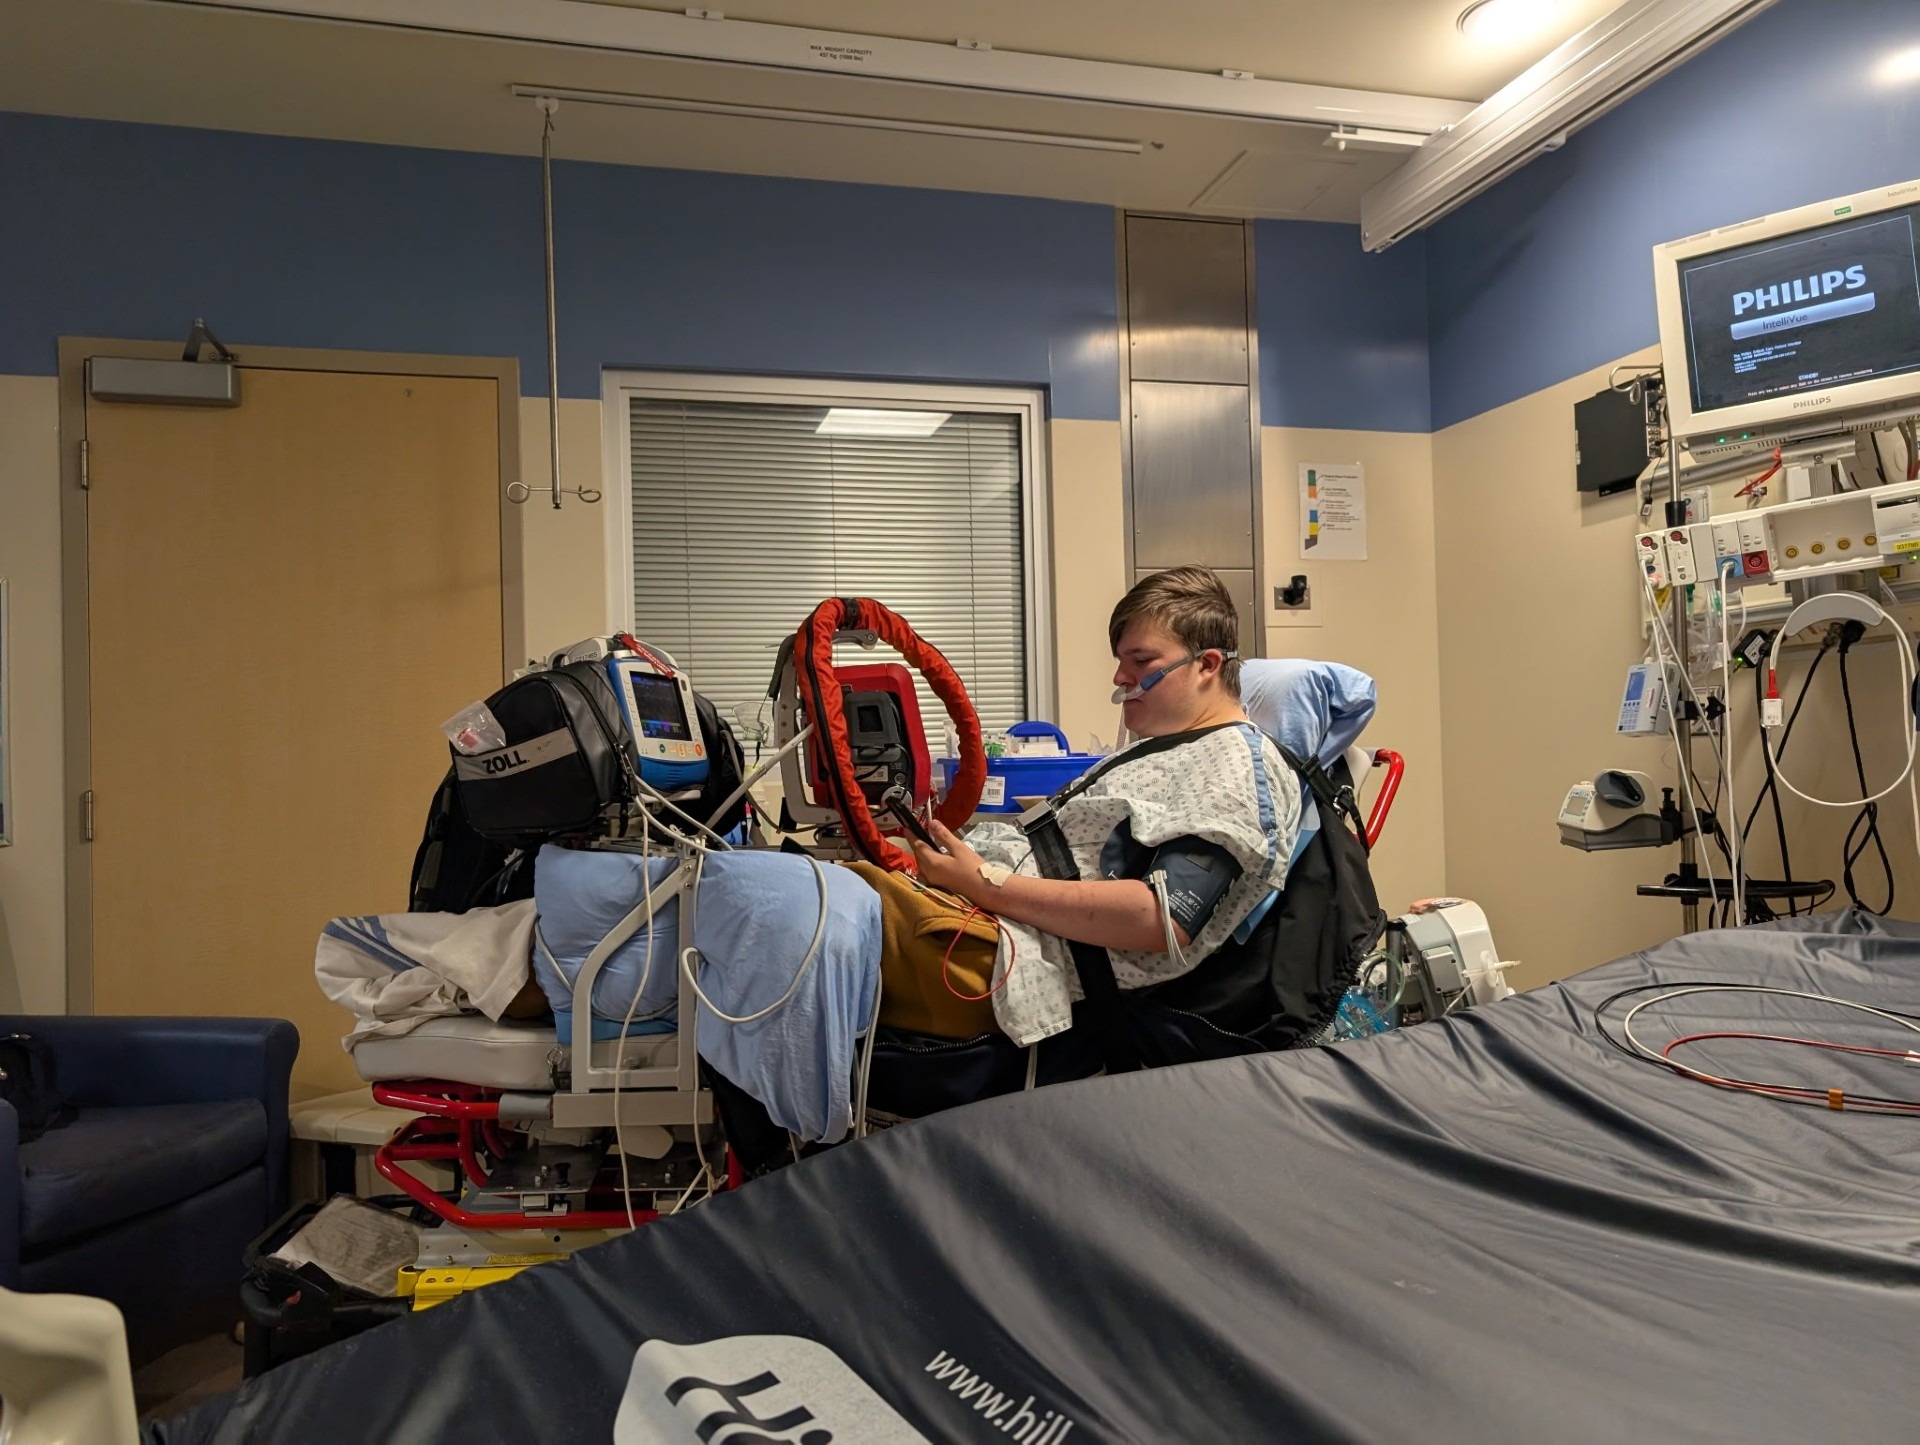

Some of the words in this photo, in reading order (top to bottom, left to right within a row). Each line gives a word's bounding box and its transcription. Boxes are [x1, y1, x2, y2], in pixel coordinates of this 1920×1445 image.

[846, 48, 872, 56] CAPACITY
[1732, 264, 1867, 316] PHILIPS
[1762, 313, 1809, 331] IntelliVue
[1798, 372, 1819, 381] STANDBY
[1792, 396, 1832, 409] PHILIPS
[481, 749, 528, 775] ZOLL
